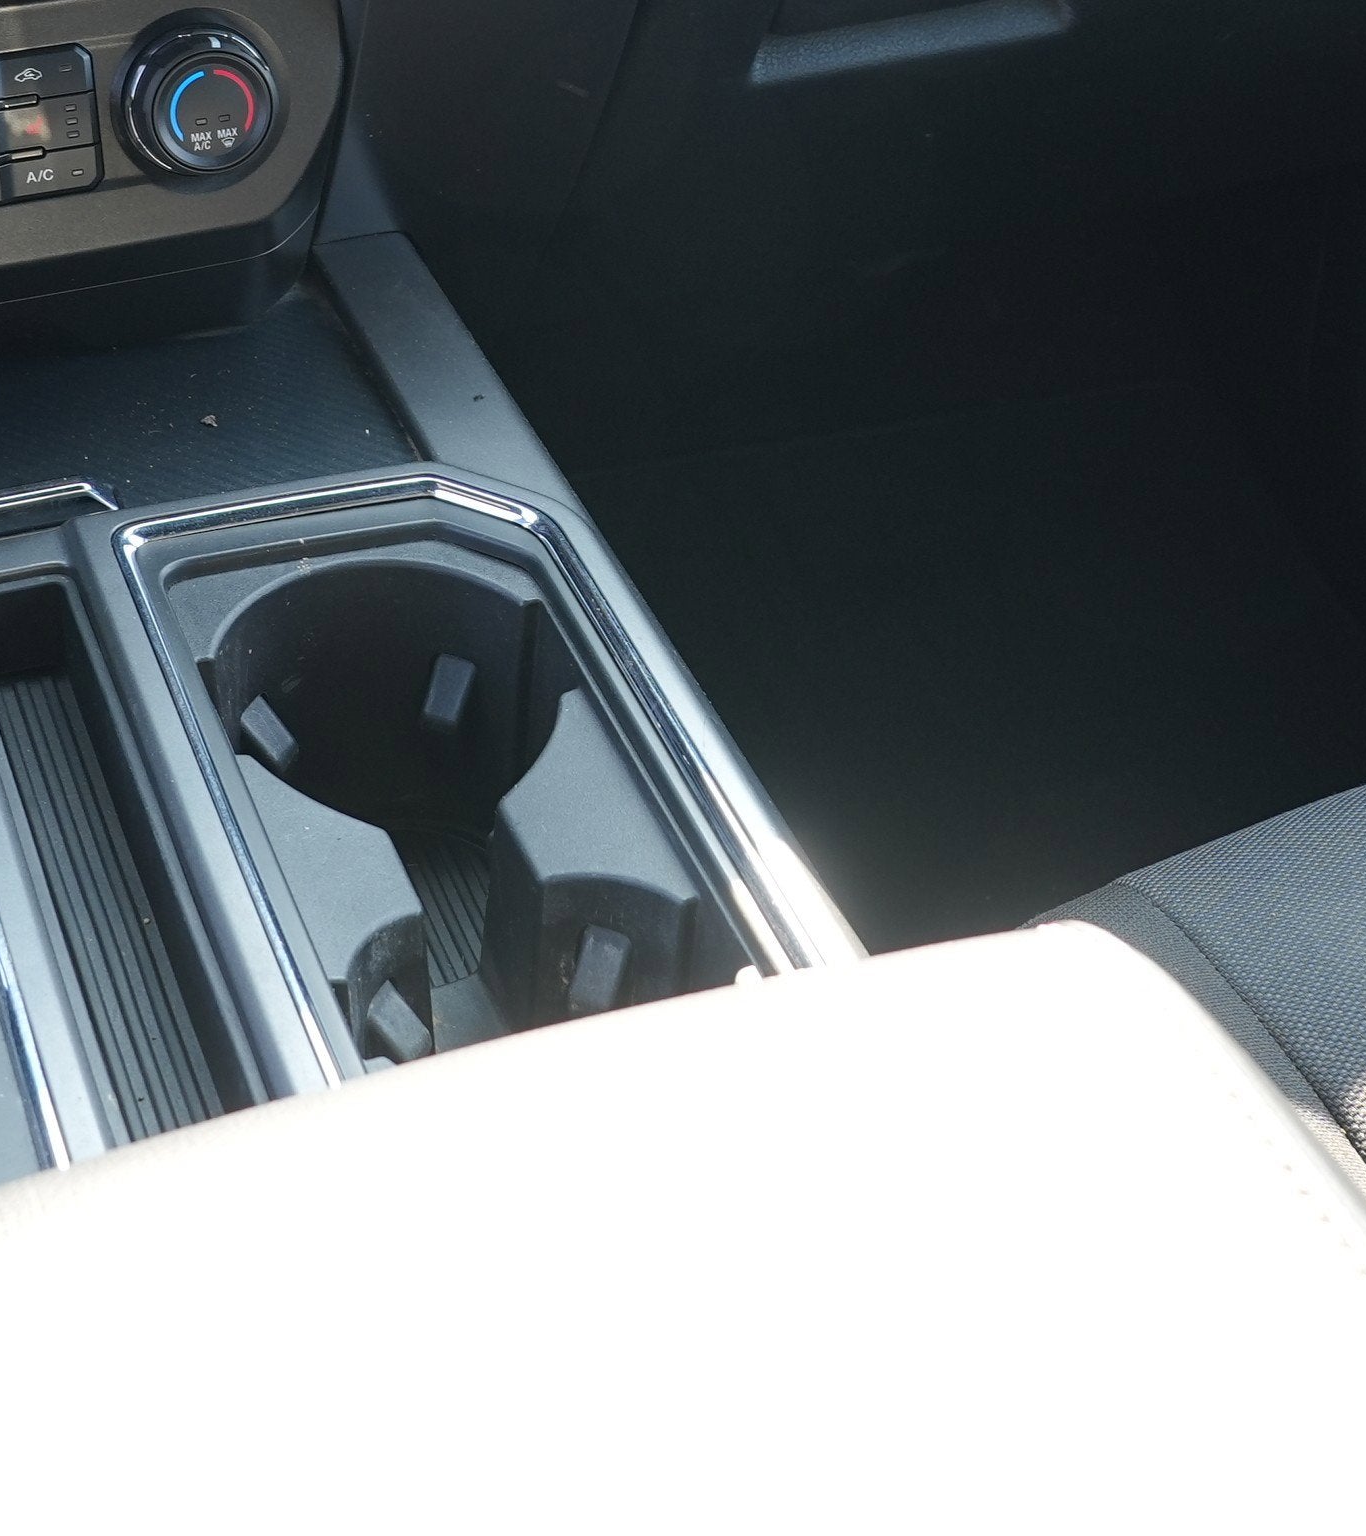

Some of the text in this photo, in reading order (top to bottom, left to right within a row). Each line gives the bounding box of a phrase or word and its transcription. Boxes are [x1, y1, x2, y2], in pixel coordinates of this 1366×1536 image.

[190, 131, 213, 143] MAX
[216, 127, 239, 139] MAX
[193, 140, 212, 152] A/C
[25, 168, 55, 184] A/C
